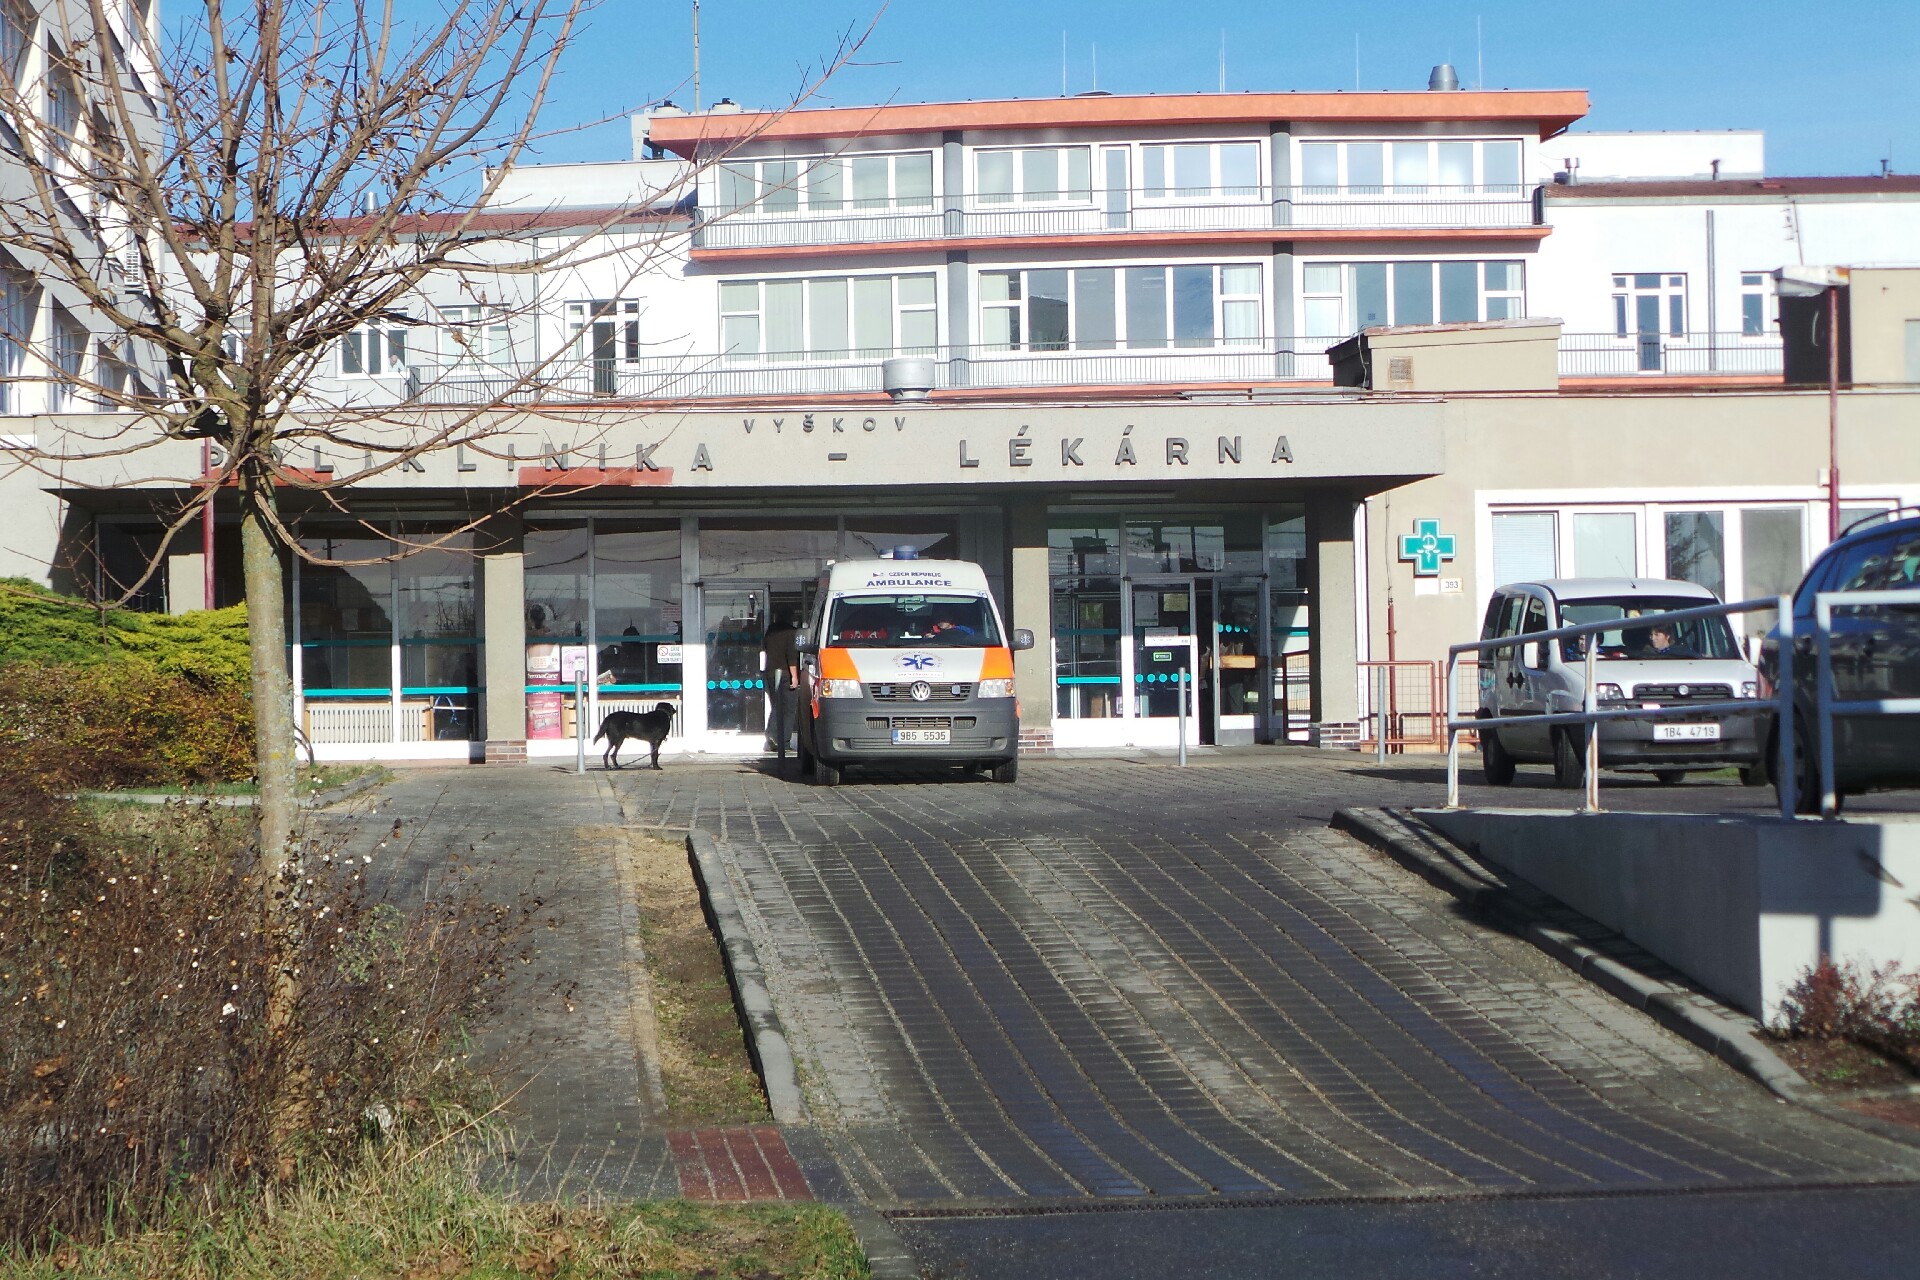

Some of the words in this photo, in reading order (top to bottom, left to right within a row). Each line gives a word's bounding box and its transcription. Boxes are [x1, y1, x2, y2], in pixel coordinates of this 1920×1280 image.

[743, 414, 906, 434] VYŠKOV
[959, 425, 1294, 468] LÉKÁRNA
[900, 731, 917, 740] 9B5
[923, 731, 946, 740] 5535
[1664, 727, 1682, 737] 1B4
[1690, 727, 1715, 737] 4719
